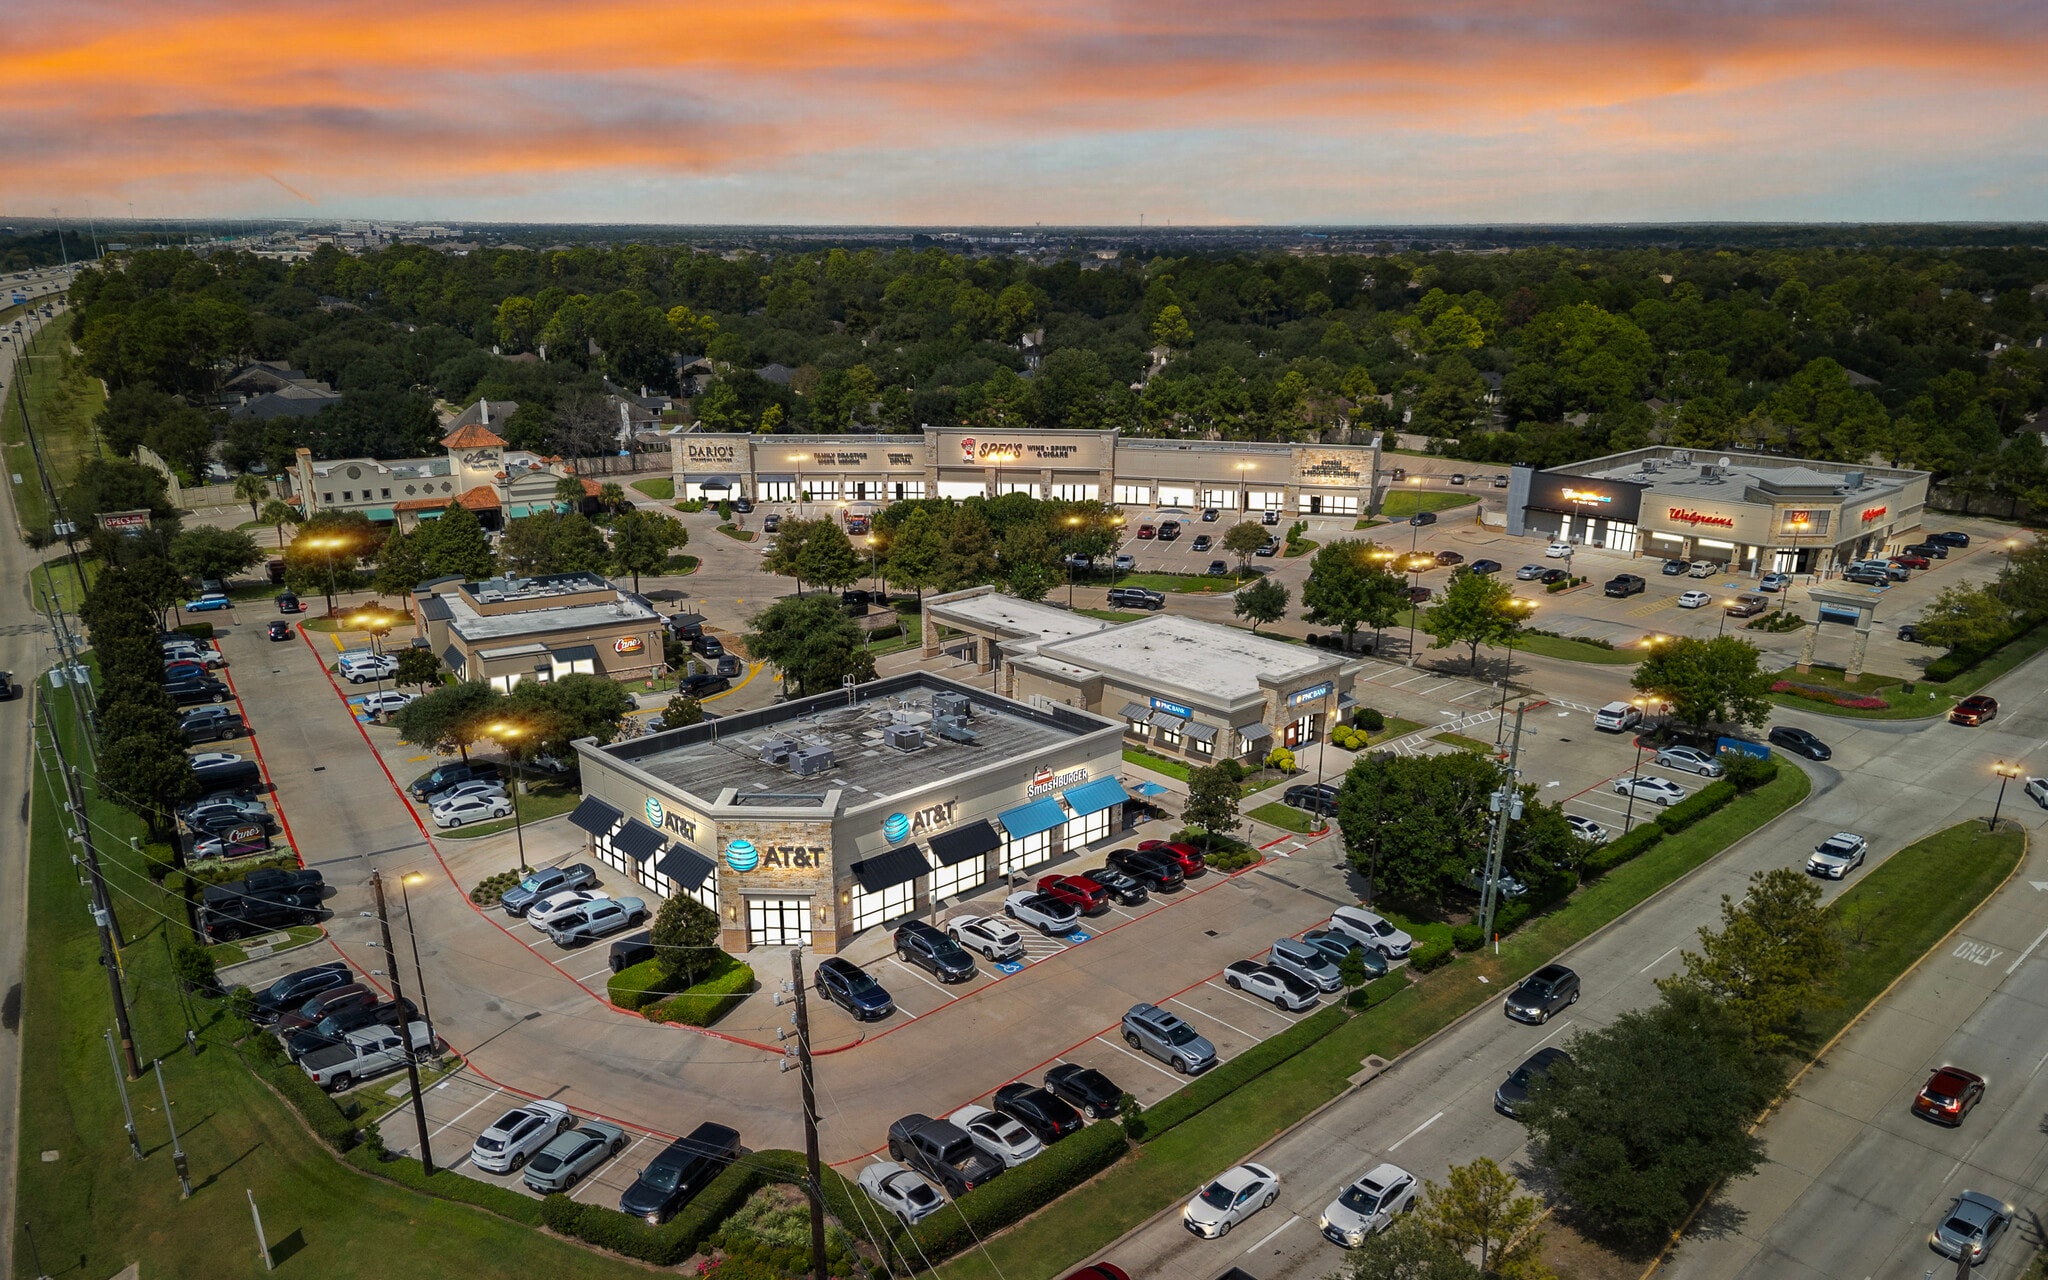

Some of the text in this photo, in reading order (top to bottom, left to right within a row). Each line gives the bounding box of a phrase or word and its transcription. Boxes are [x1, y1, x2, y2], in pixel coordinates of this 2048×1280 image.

[688, 445, 735, 458] DARIO'S
[979, 442, 1023, 459] SPEC'S
[1050, 445, 1077, 453] SPIRITS
[1669, 508, 1734, 527] Walgreens
[1302, 692, 1313, 702] PNC
[1161, 702, 1186, 714] PNC BANK
[912, 800, 956, 832] AT&T
[229, 825, 260, 844] Cane's
[665, 811, 696, 843] AT&T
[763, 846, 825, 868] AT&T
[1952, 941, 2004, 967] ONLY
